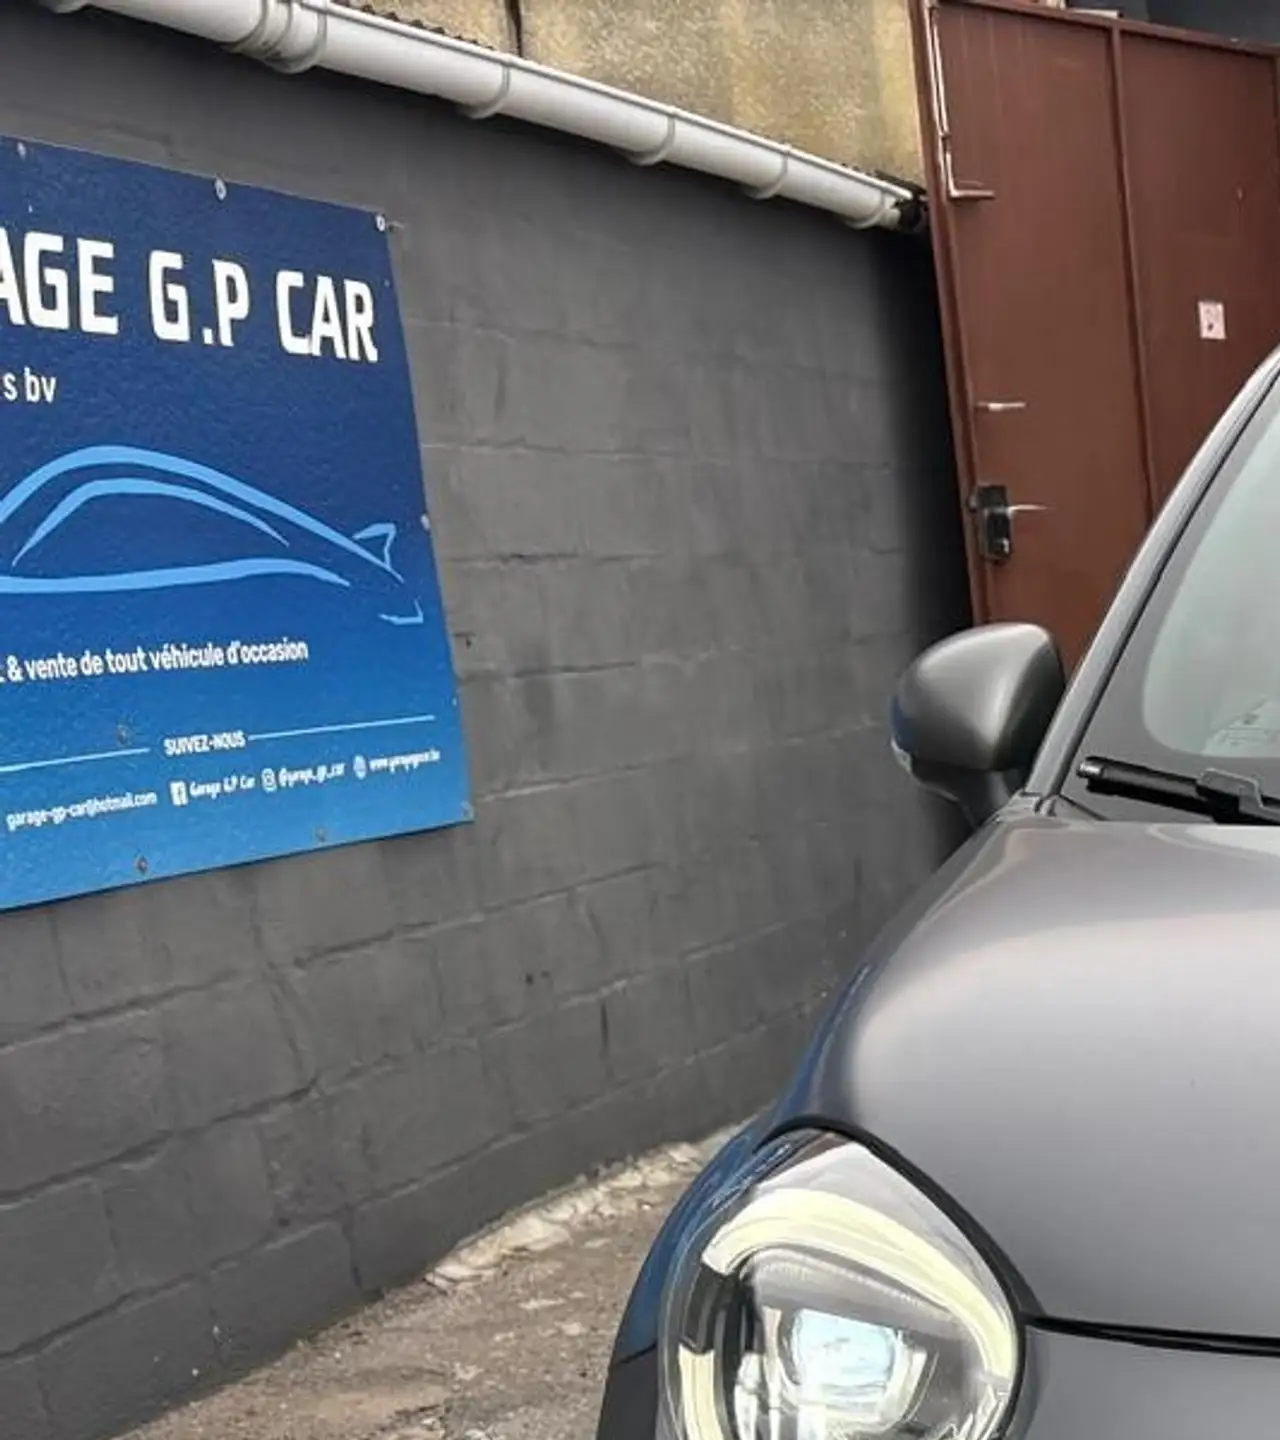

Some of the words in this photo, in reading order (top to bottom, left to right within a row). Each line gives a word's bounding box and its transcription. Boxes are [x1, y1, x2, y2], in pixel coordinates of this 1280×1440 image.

[149, 250, 249, 347] G.P
[276, 270, 378, 362] CAR
[24, 366, 57, 403] bv
[7, 655, 24, 682] &
[26, 653, 77, 681] vente
[80, 650, 104, 676] de
[105, 646, 148, 673] tout
[150, 642, 224, 670] véhicule
[227, 637, 308, 664] d'occasion
[164, 731, 246, 757] SUIVEZ-NOUS
